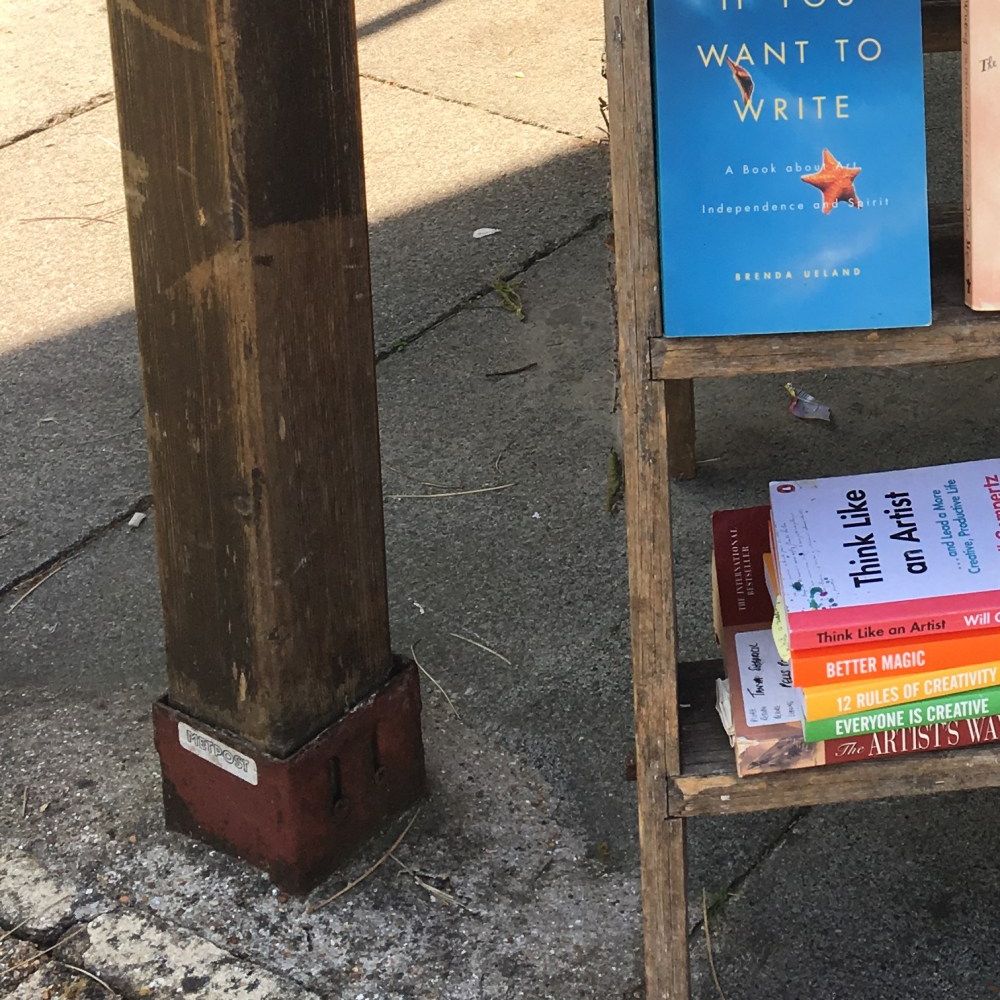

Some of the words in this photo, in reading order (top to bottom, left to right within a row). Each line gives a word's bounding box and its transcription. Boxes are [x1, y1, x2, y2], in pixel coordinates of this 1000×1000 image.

[697, 40, 809, 68] WANT
[835, 38, 882, 62] TO
[979, 55, 997, 73] The
[733, 95, 849, 122] WRITE
[725, 166, 734, 175] A
[742, 163, 777, 174] Book
[702, 202, 804, 215] Independence
[813, 198, 838, 209] and
[848, 198, 889, 210] Spirit
[735, 270, 793, 281] BRENDA
[803, 267, 861, 279] UELAND
[933, 489, 944, 511] More
[944, 479, 959, 495] Life
[836, 489, 872, 528] Like
[884, 492, 921, 543] Artist
[951, 496, 969, 537] Productive
[936, 520, 951, 540] Lead
[730, 528, 745, 595] INTERNATIONAL
[842, 532, 884, 588] Think
[904, 549, 928, 574] an
[963, 538, 981, 575] Creative,
[817, 630, 853, 644] Think
[858, 628, 884, 639] Like
[888, 625, 906, 635] an
[910, 620, 946, 633] Artist
[964, 613, 991, 627] Will
[826, 658, 877, 679] BETTER
[882, 650, 926, 671] MAGIC
[836, 696, 851, 712] 12
[856, 686, 899, 709] RULES
[903, 682, 920, 699] OF
[924, 667, 998, 696] CREATIVITY
[835, 711, 904, 736] EVERYONE
[909, 708, 923, 725] IS
[926, 698, 990, 722] CREATIVE
[186, 729, 250, 773] METPOST
[835, 742, 865, 757] The
[868, 721, 960, 757] ARTIST'S
